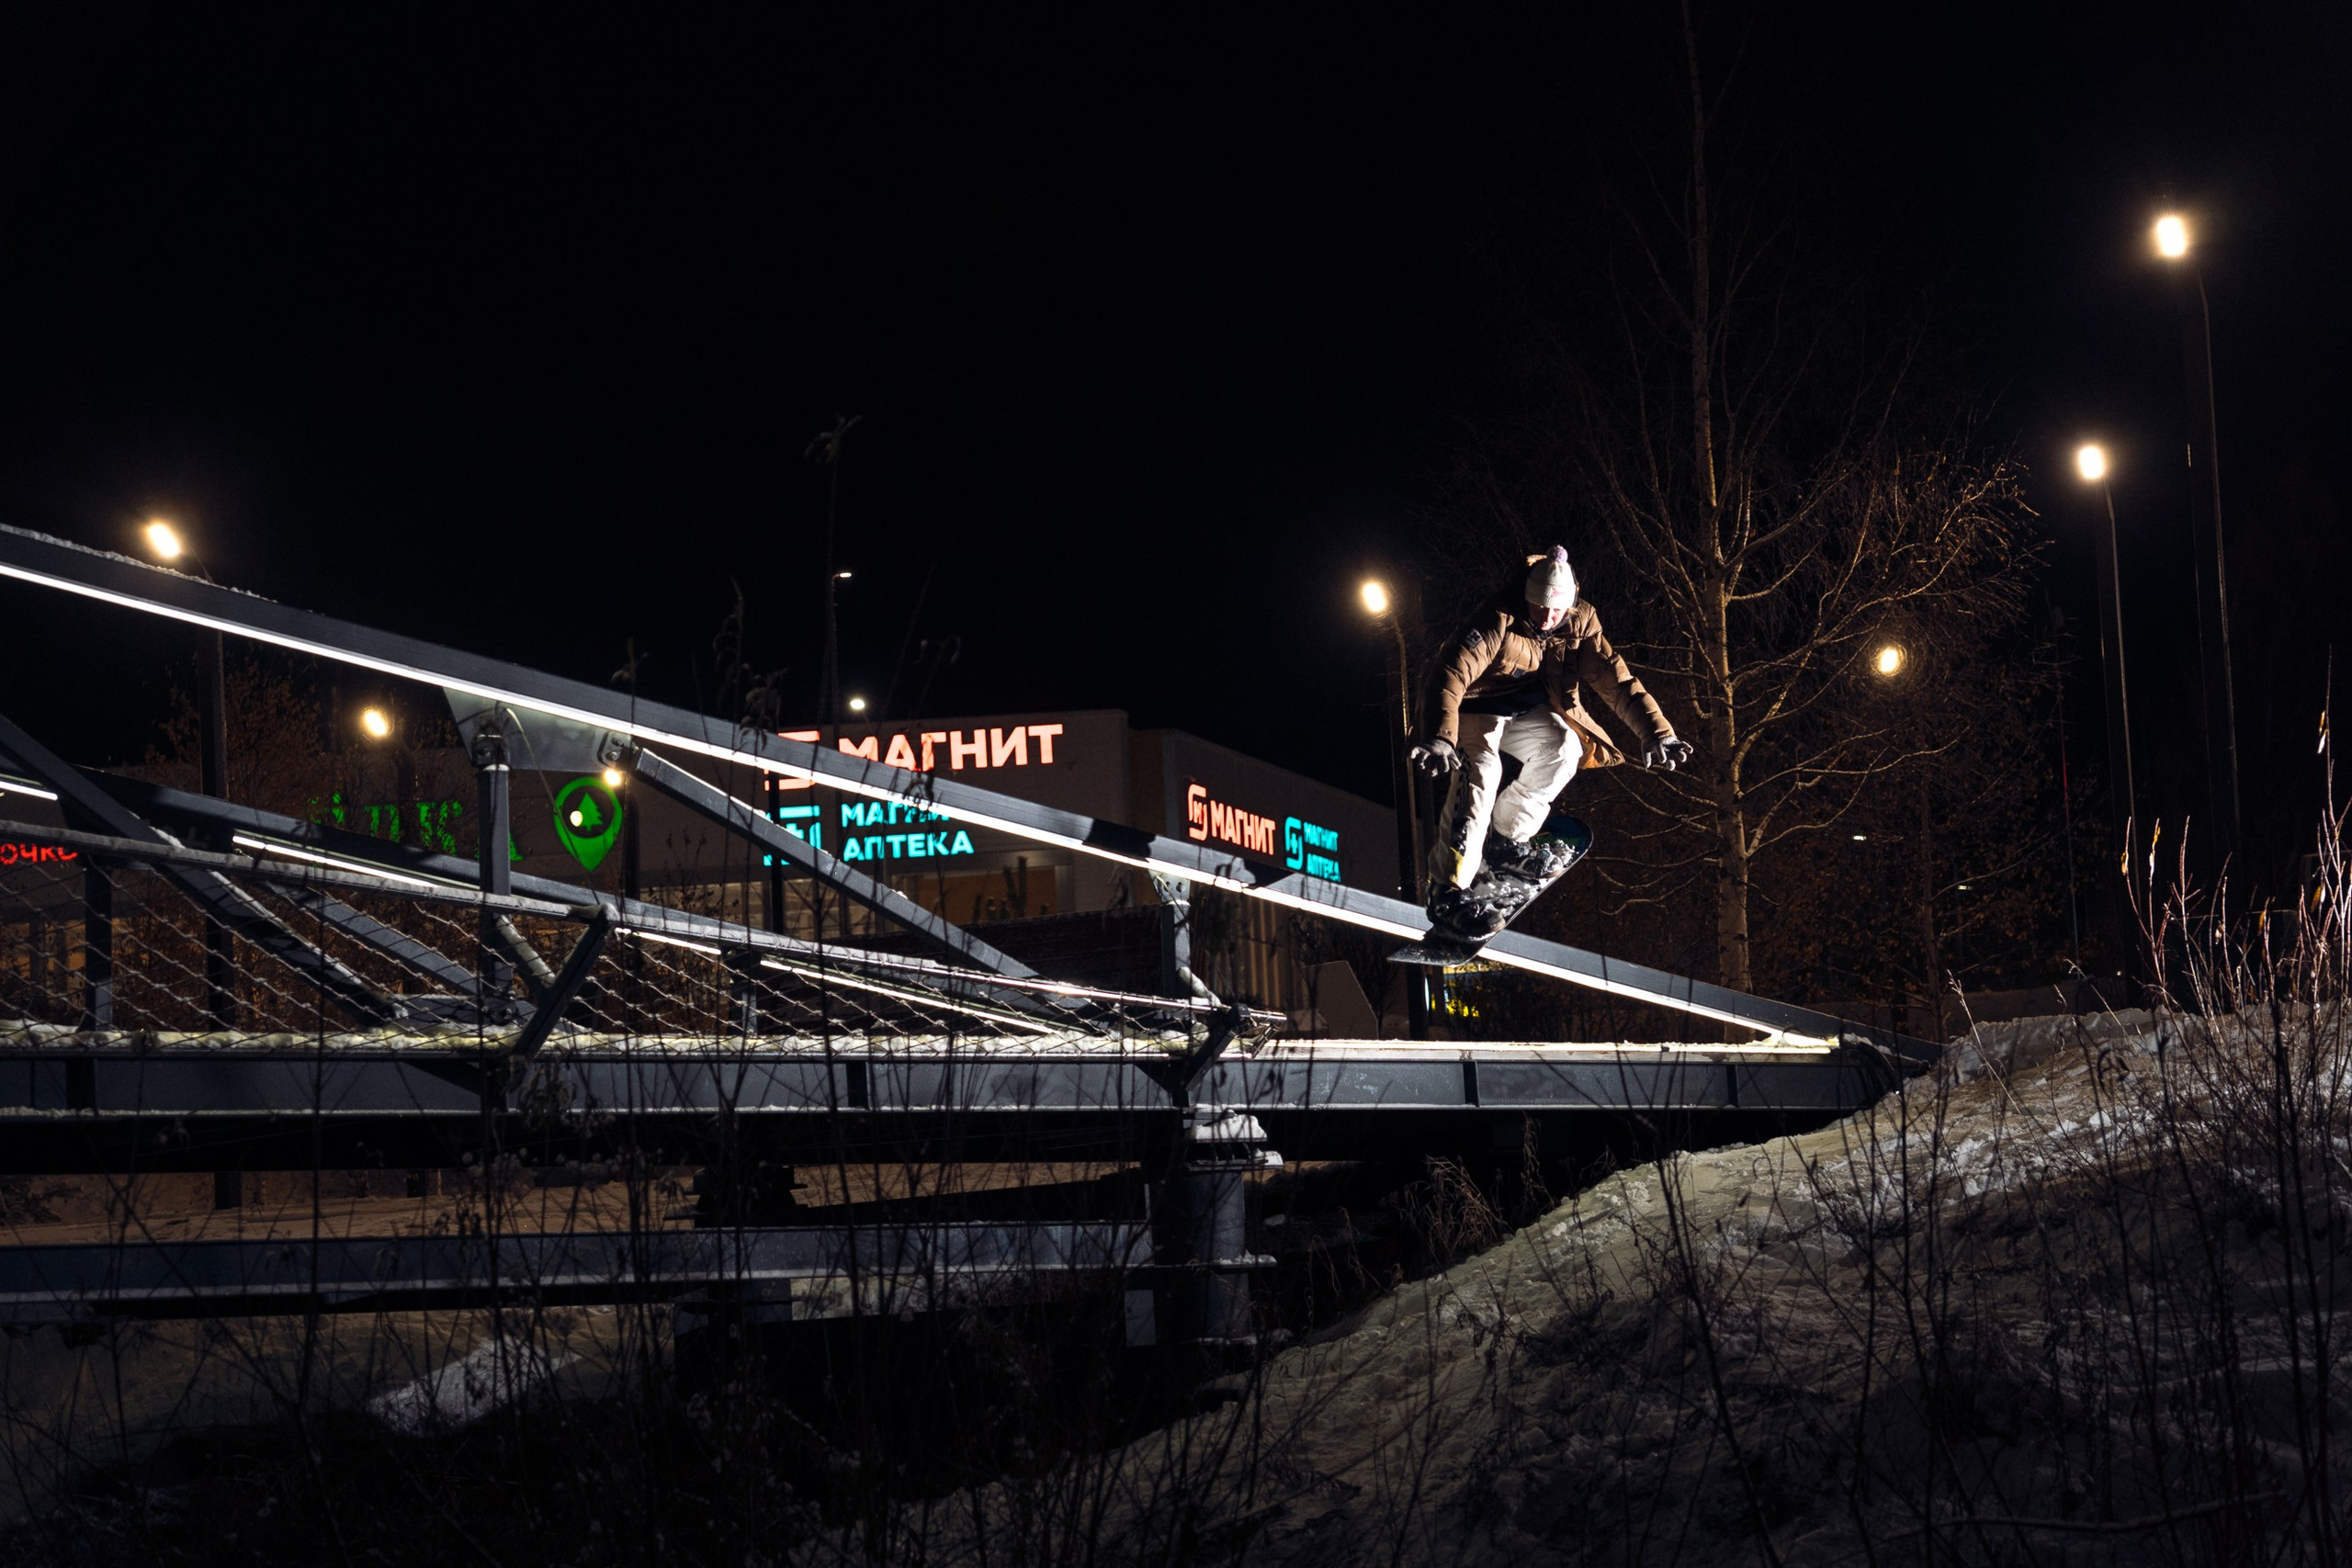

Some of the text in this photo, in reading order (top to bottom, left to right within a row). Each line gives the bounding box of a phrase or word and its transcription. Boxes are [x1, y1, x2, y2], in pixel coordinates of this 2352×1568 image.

[839, 723, 1063, 771] МАГНИТ
[843, 830, 974, 862] АПТЕКА
[1210, 799, 1275, 855] МАГНИТ
